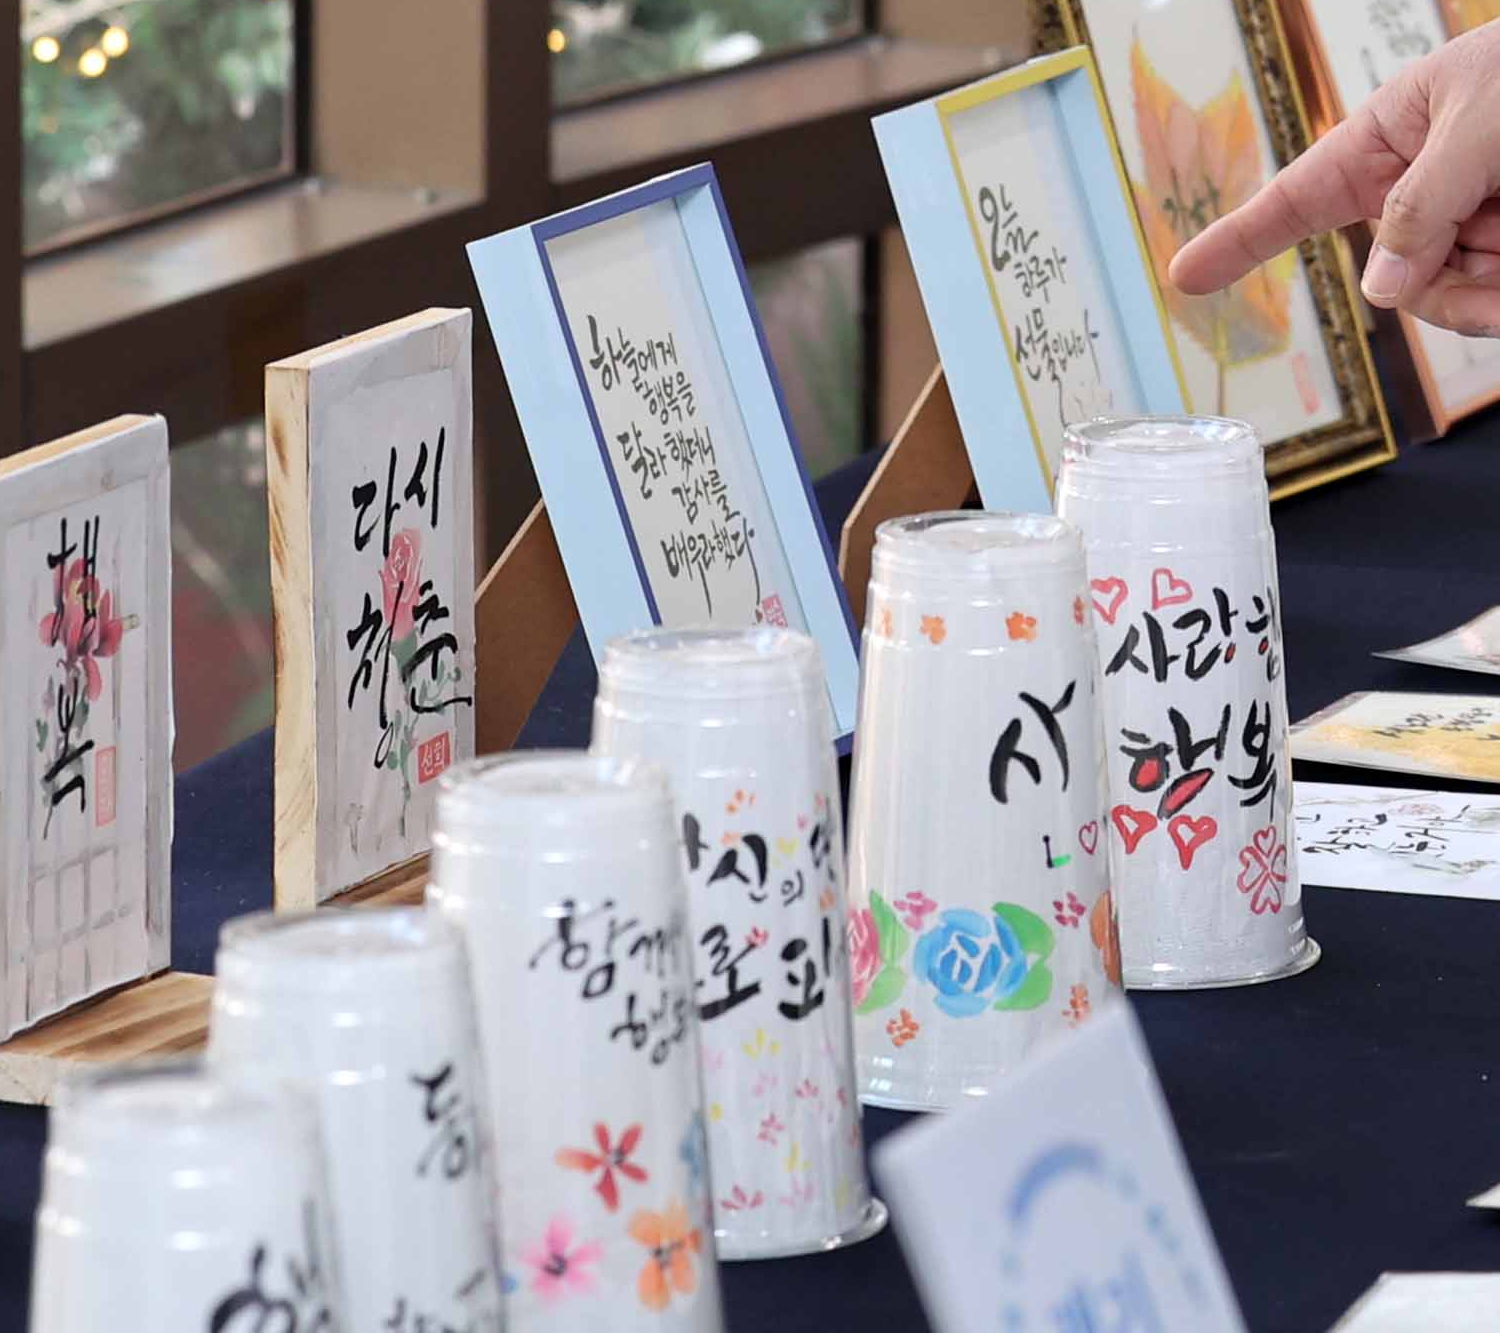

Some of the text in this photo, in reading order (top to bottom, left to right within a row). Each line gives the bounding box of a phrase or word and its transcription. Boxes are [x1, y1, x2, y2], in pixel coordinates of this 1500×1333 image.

[978, 183, 1040, 272] 오늘
[1013, 244, 1067, 305] 하루가
[586, 313, 679, 393] 하늘에게
[642, 370, 697, 426] 행복을
[1014, 308, 1102, 411] 선물입니다
[350, 425, 447, 556] 다시
[670, 467, 741, 526] 감사를
[40, 515, 102, 842] 행복
[345, 578, 474, 771] 청춘
[988, 678, 1080, 805] 사
[1118, 698, 1279, 823] 행복
[696, 923, 762, 1022] 로
